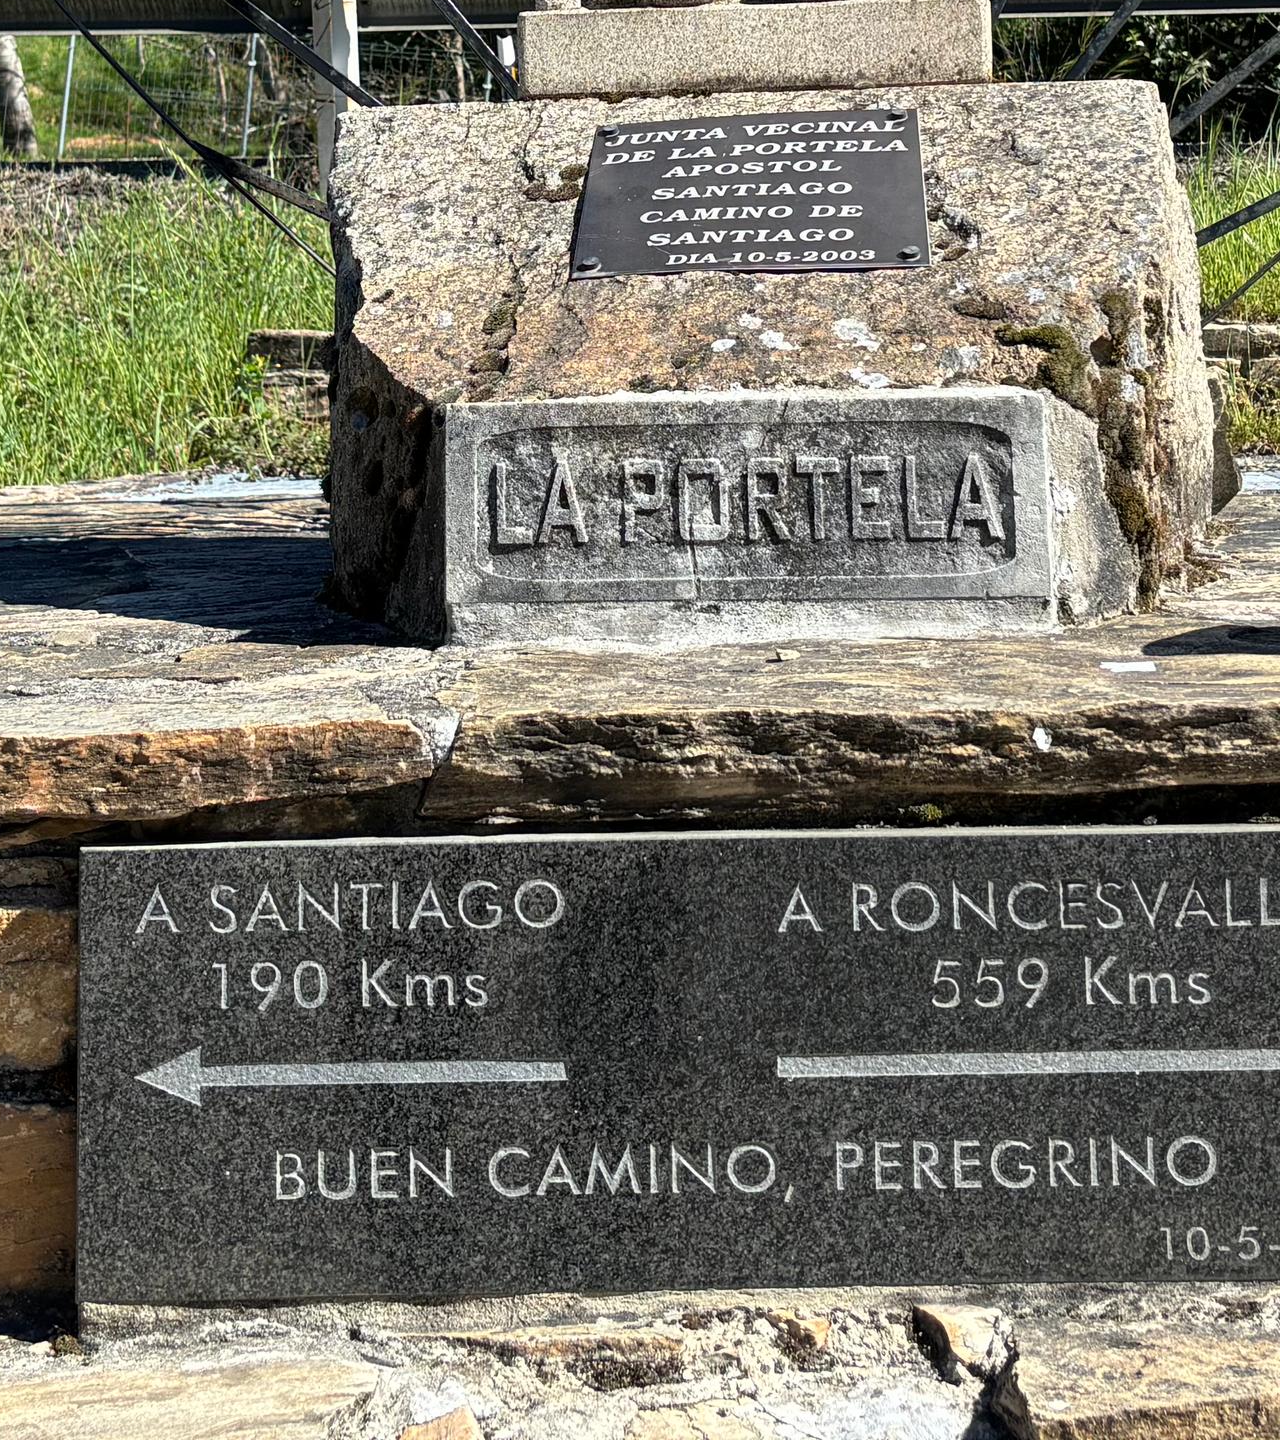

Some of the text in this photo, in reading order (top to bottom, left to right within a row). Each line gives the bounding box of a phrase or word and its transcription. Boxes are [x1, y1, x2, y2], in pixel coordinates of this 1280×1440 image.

[603, 119, 906, 148] JUNTA VECINAL
[601, 149, 655, 166] DE
[732, 137, 909, 157] PORTELA
[661, 159, 843, 179] APOSTOL
[651, 181, 853, 201] SANTIAGO
[639, 204, 863, 224] CAMINO DE
[646, 227, 856, 247] SANTIAGO
[665, 248, 876, 266] DIA 10-5-2003
[491, 453, 1007, 551] LA PORTELA
[135, 878, 565, 934] A SANTIAGO
[778, 884, 823, 933] A
[213, 958, 489, 1012] 190 Kms
[931, 956, 1213, 1009] 559 Kms
[275, 1134, 1218, 1203] BUEN CAMINO, PEREGRINO
